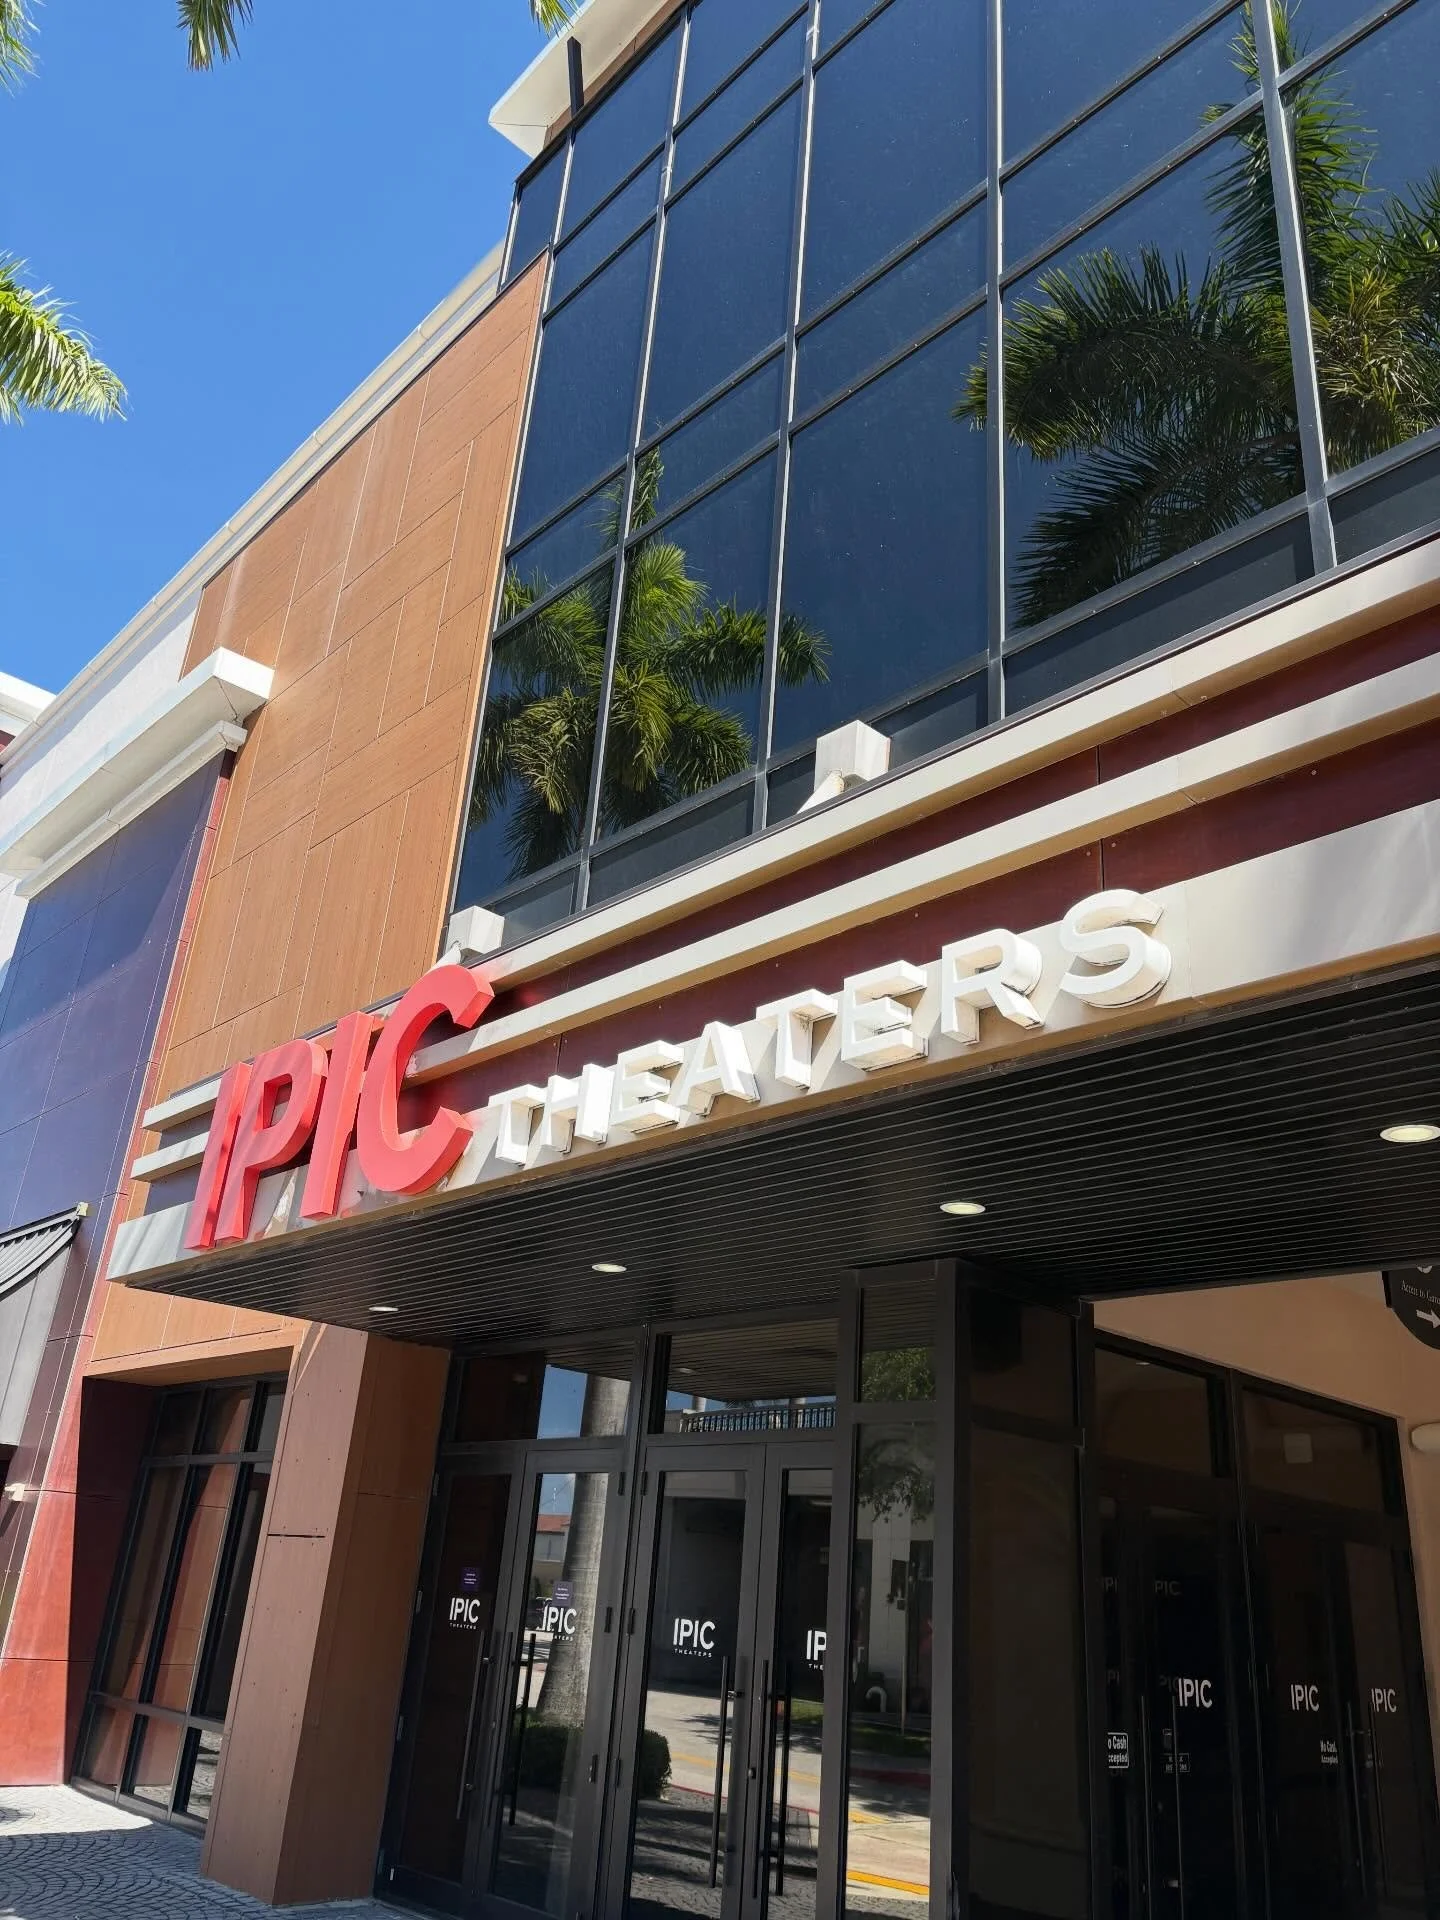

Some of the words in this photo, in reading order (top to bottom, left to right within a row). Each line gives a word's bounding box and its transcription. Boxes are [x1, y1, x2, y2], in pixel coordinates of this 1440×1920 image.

[184, 965, 495, 1250] IPIC
[488, 889, 1171, 1166] THEATERS
[449, 1597, 480, 1624] IPIC
[542, 1604, 577, 1635] IPIC
[673, 1618, 716, 1650] IPIC
[674, 1649, 712, 1658] THEATERS
[1178, 1677, 1213, 1708] IPIC
[1290, 1684, 1320, 1712] IPIC
[1371, 1688, 1397, 1713] IPIC
[1113, 1736, 1127, 1750] Cash
